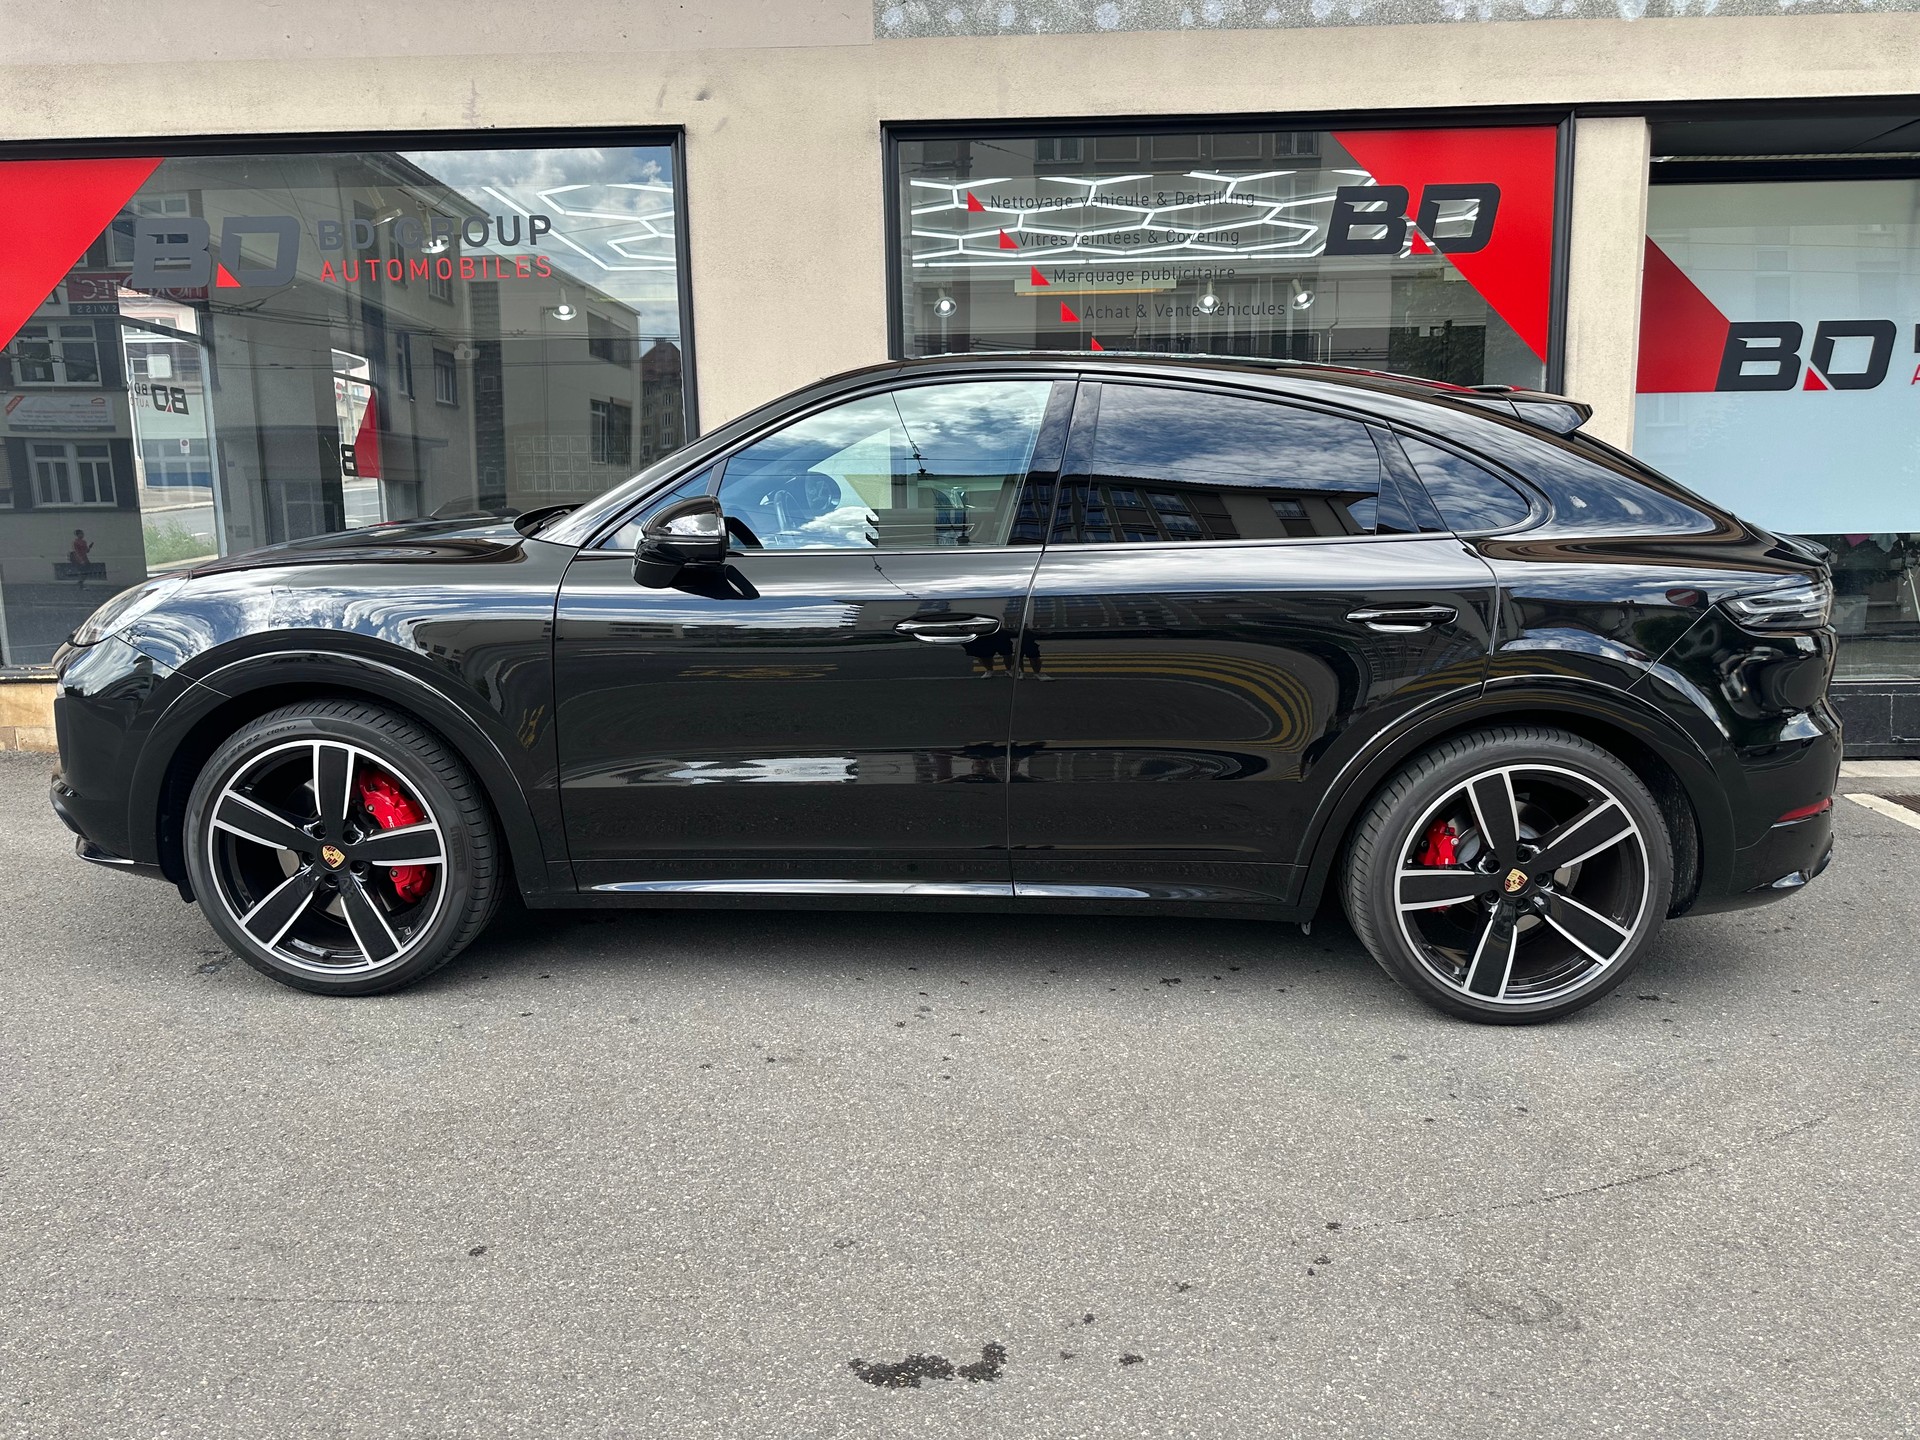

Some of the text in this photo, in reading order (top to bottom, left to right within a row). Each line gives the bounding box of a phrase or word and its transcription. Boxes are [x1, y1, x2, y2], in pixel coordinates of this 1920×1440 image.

[990, 194, 1073, 211] Nettoyage
[1157, 192, 1167, 205] &
[318, 215, 551, 250] BD GROUP
[1323, 183, 1501, 256] BD
[132, 216, 300, 287] BD
[1019, 229, 1239, 247] Vitres teintées & Covering
[320, 255, 552, 282] AUTOMOBILES
[1054, 265, 1235, 285] Marquage publicitaire
[1085, 305, 1130, 319] Achat
[1136, 304, 1147, 318] &
[1154, 303, 1200, 317] Vente
[1714, 319, 1897, 392] BD
